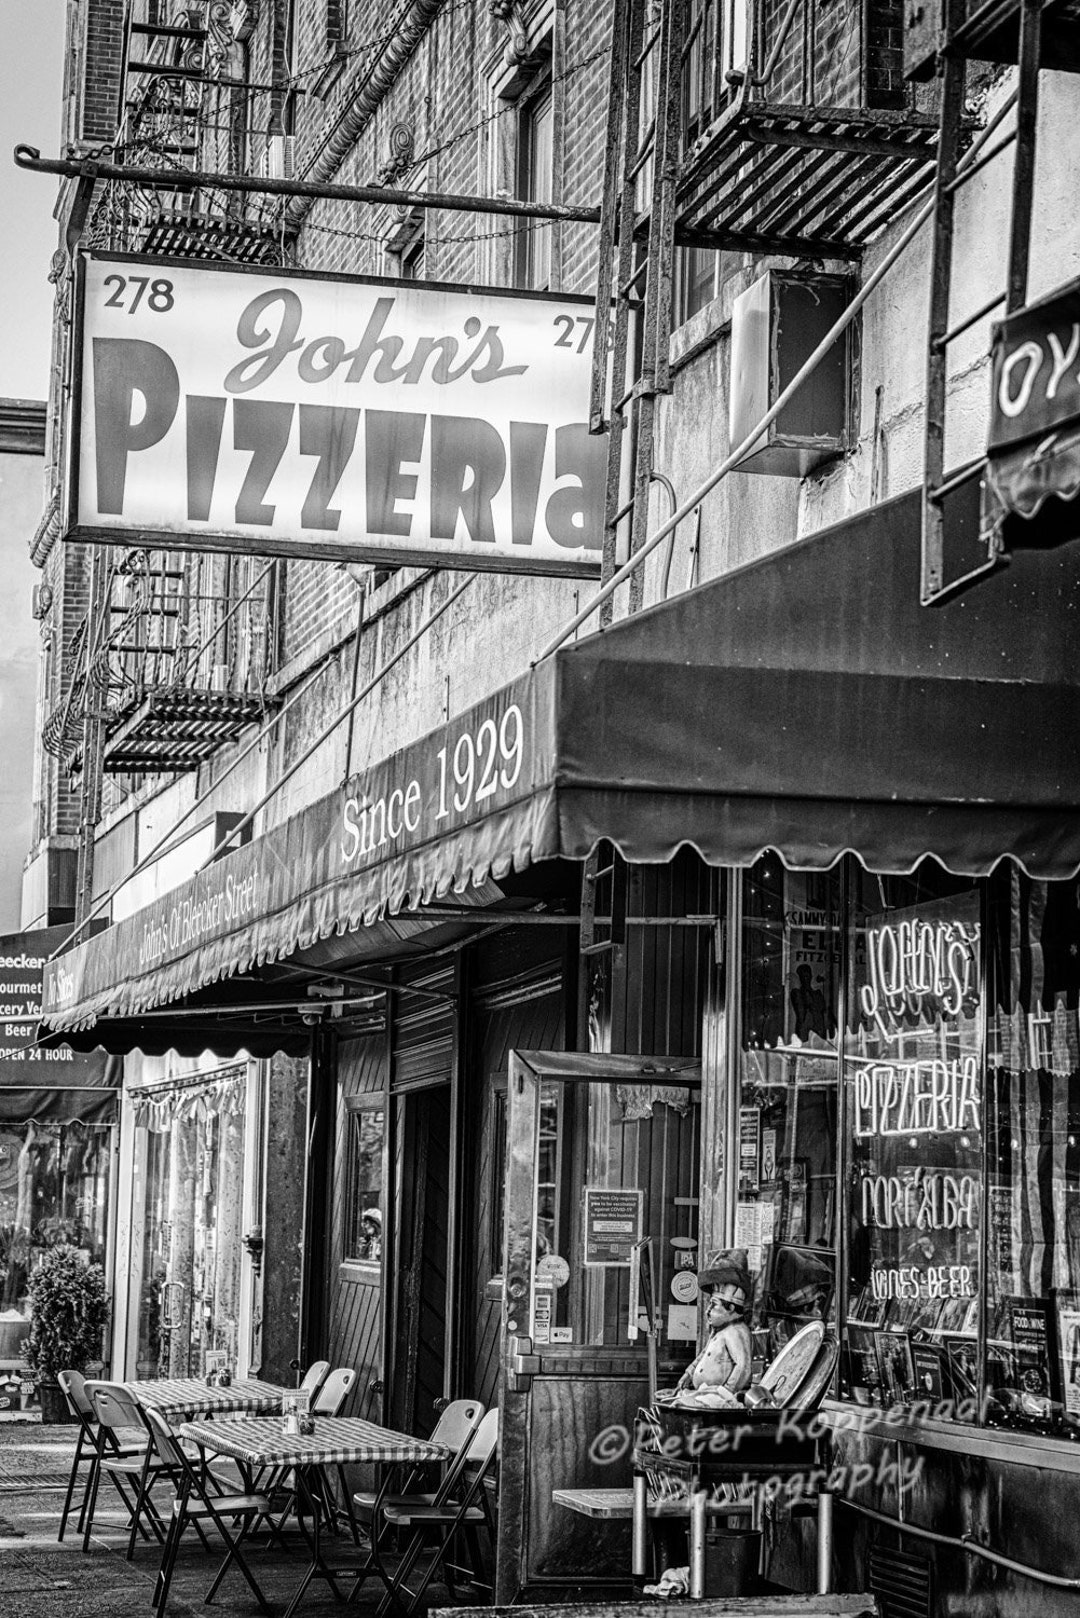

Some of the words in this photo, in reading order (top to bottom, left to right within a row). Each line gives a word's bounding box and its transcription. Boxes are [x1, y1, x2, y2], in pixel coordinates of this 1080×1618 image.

[103, 274, 175, 315] 278
[223, 287, 529, 394] John's
[341, 779, 421, 863] Since
[434, 704, 524, 821] 1929
[224, 868, 259, 922] Street
[5, 1023, 33, 1037] Beer
[28, 1048, 42, 1061] 24
[45, 1049, 74, 1061] HOUR
[855, 1056, 981, 1136] PIZZERIA
